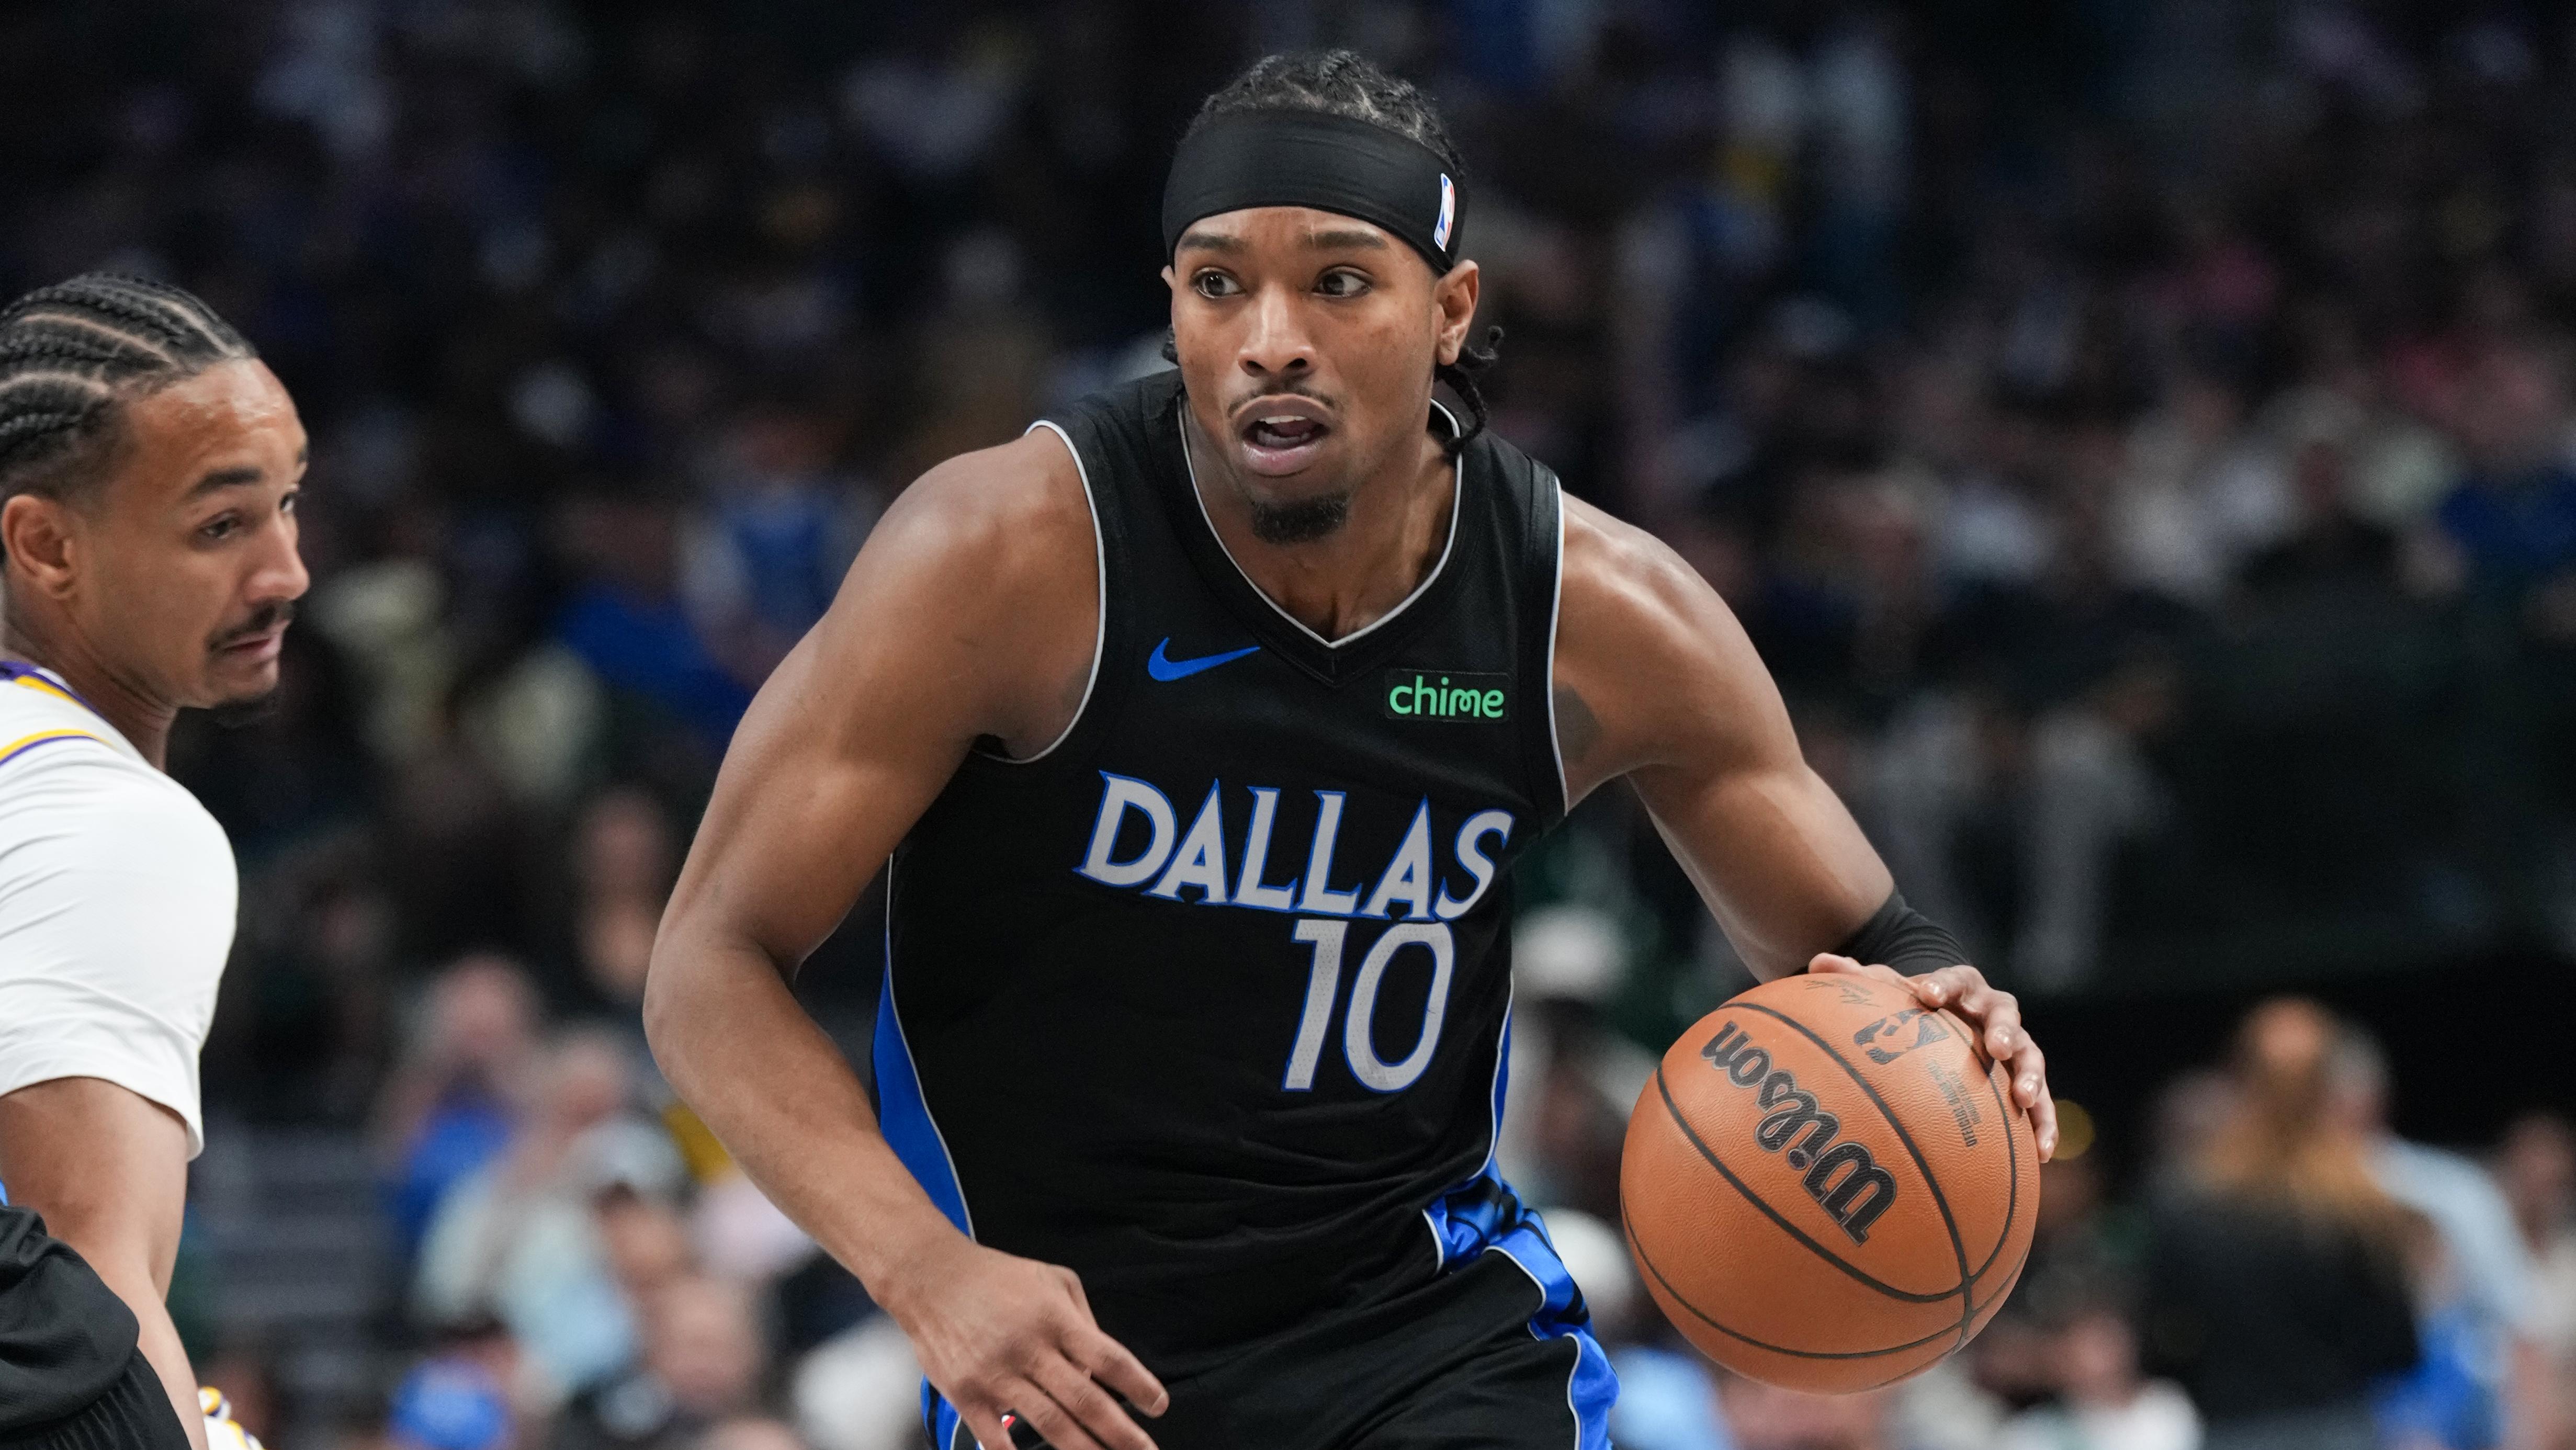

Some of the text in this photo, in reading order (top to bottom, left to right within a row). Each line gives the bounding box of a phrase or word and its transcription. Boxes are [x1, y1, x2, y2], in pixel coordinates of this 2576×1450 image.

[1389, 675, 1505, 718] chime
[1072, 769, 1515, 922] DALLAS
[1282, 918, 1454, 1094] 10
[1701, 1020, 1897, 1247] Wilson
